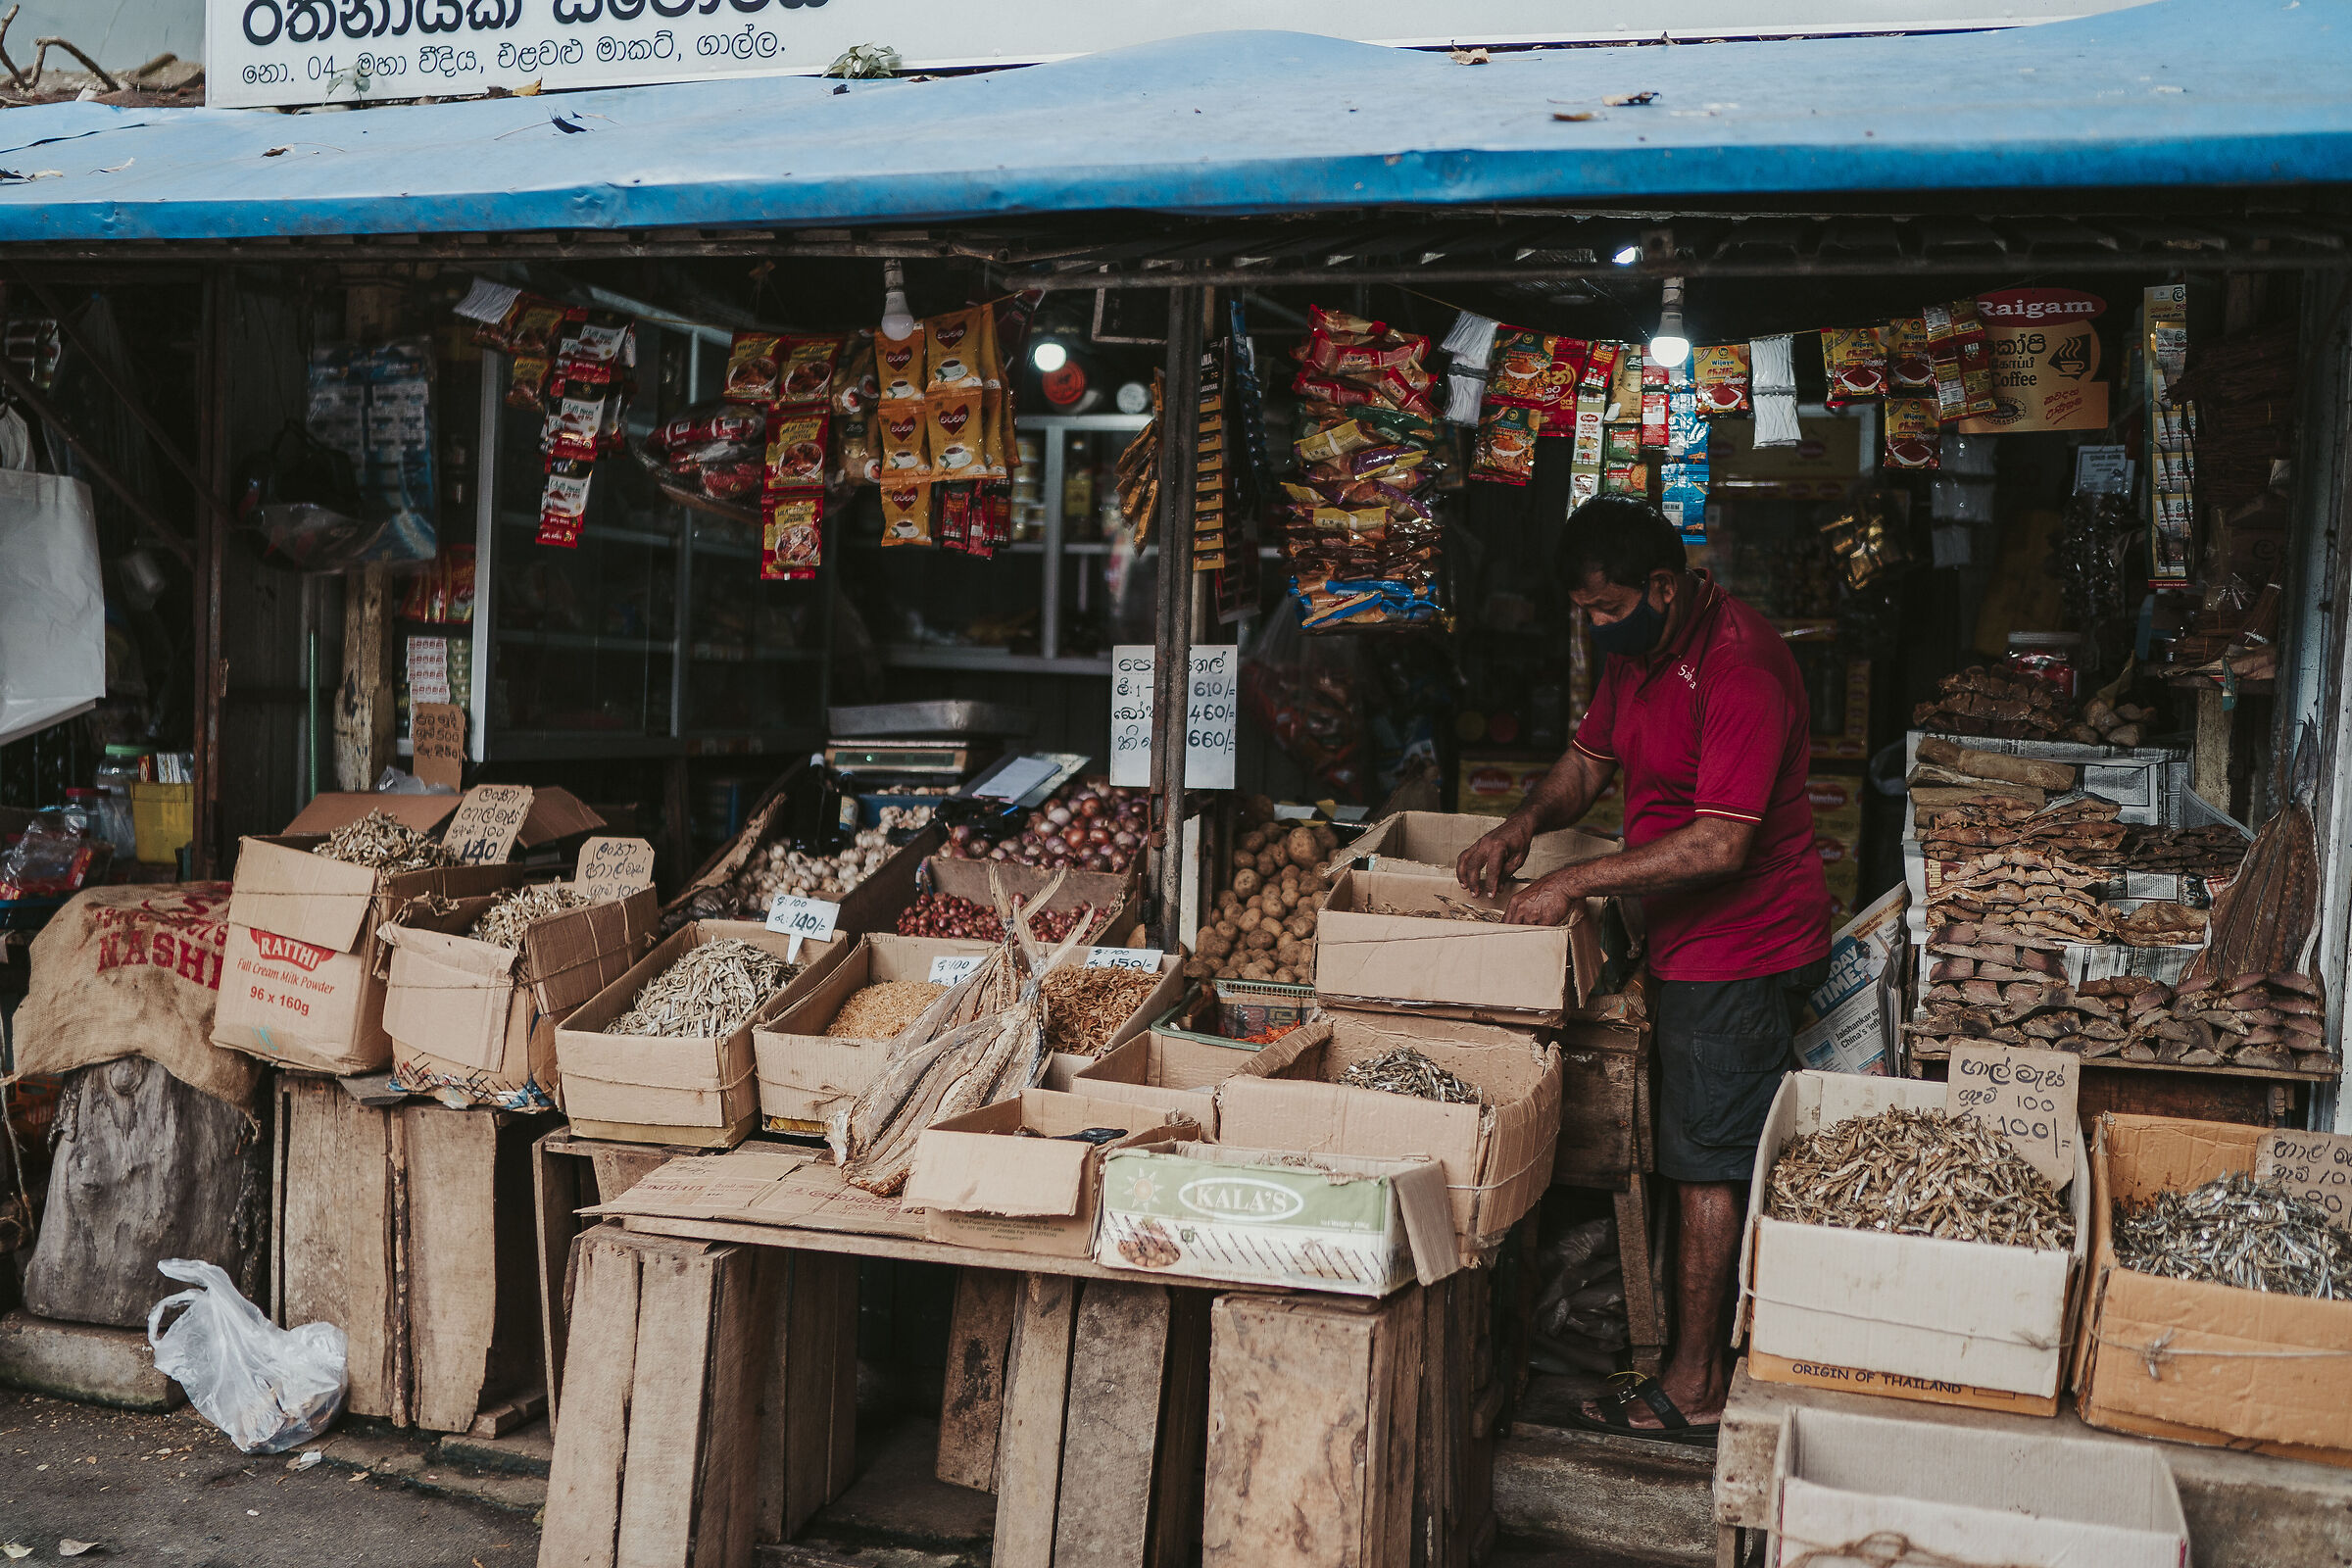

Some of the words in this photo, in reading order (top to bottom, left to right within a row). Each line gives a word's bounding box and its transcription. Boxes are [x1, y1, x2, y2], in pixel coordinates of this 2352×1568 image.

[308, 56, 335, 79] 04
[1978, 299, 2095, 318] Raigam
[1991, 370, 2037, 388] Coffee
[482, 825, 504, 838] 100
[790, 899, 808, 907] 100
[98, 931, 223, 991] NASHI
[261, 937, 319, 968] RATTHI
[1829, 945, 1859, 982] DAY
[237, 958, 251, 970] Full
[253, 962, 278, 980] Cream
[280, 970, 299, 986] Milk
[301, 976, 334, 995] Powder
[250, 986, 265, 1001] 96
[280, 995, 310, 1016] 160g
[1836, 1012, 1871, 1041] Jaishankar
[1840, 1030, 1867, 1050] China's
[2017, 1095, 2055, 1112] 100
[2319, 1169, 2352, 1184] 10
[1197, 1184, 1288, 1213] KALA'S
[1792, 1363, 1849, 1380] ORIGIN
[1855, 1371, 1876, 1383] OF
[1881, 1373, 1962, 1395] THAILAND
